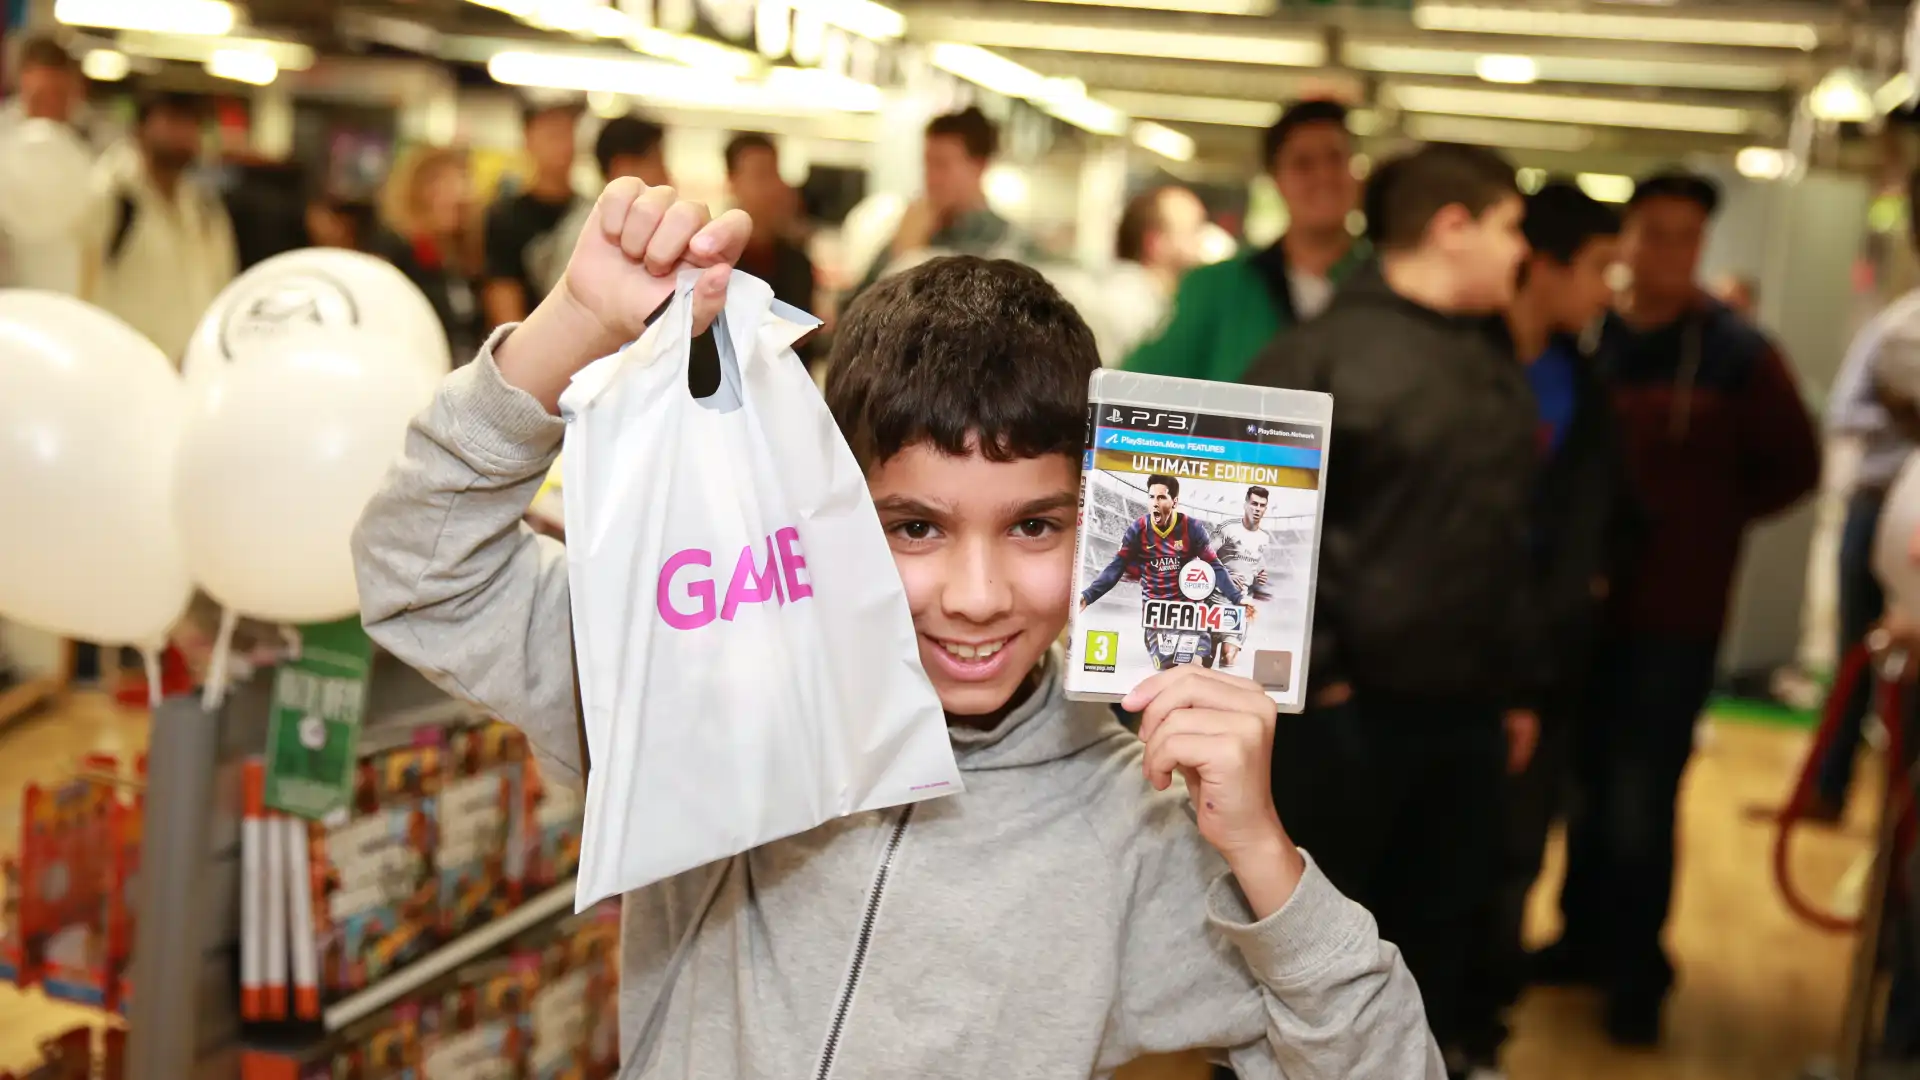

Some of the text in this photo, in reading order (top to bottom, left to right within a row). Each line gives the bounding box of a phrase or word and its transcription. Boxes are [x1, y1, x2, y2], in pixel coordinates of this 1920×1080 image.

[1187, 442, 1226, 454] FEATURES
[1132, 454, 1279, 483] ULTIMATE EDITION
[656, 526, 814, 631] GAME
[1184, 582, 1210, 590] SPORTS
[1186, 568, 1209, 582] EA
[1146, 602, 1221, 630] FIFA 14
[1094, 635, 1109, 662] 3
